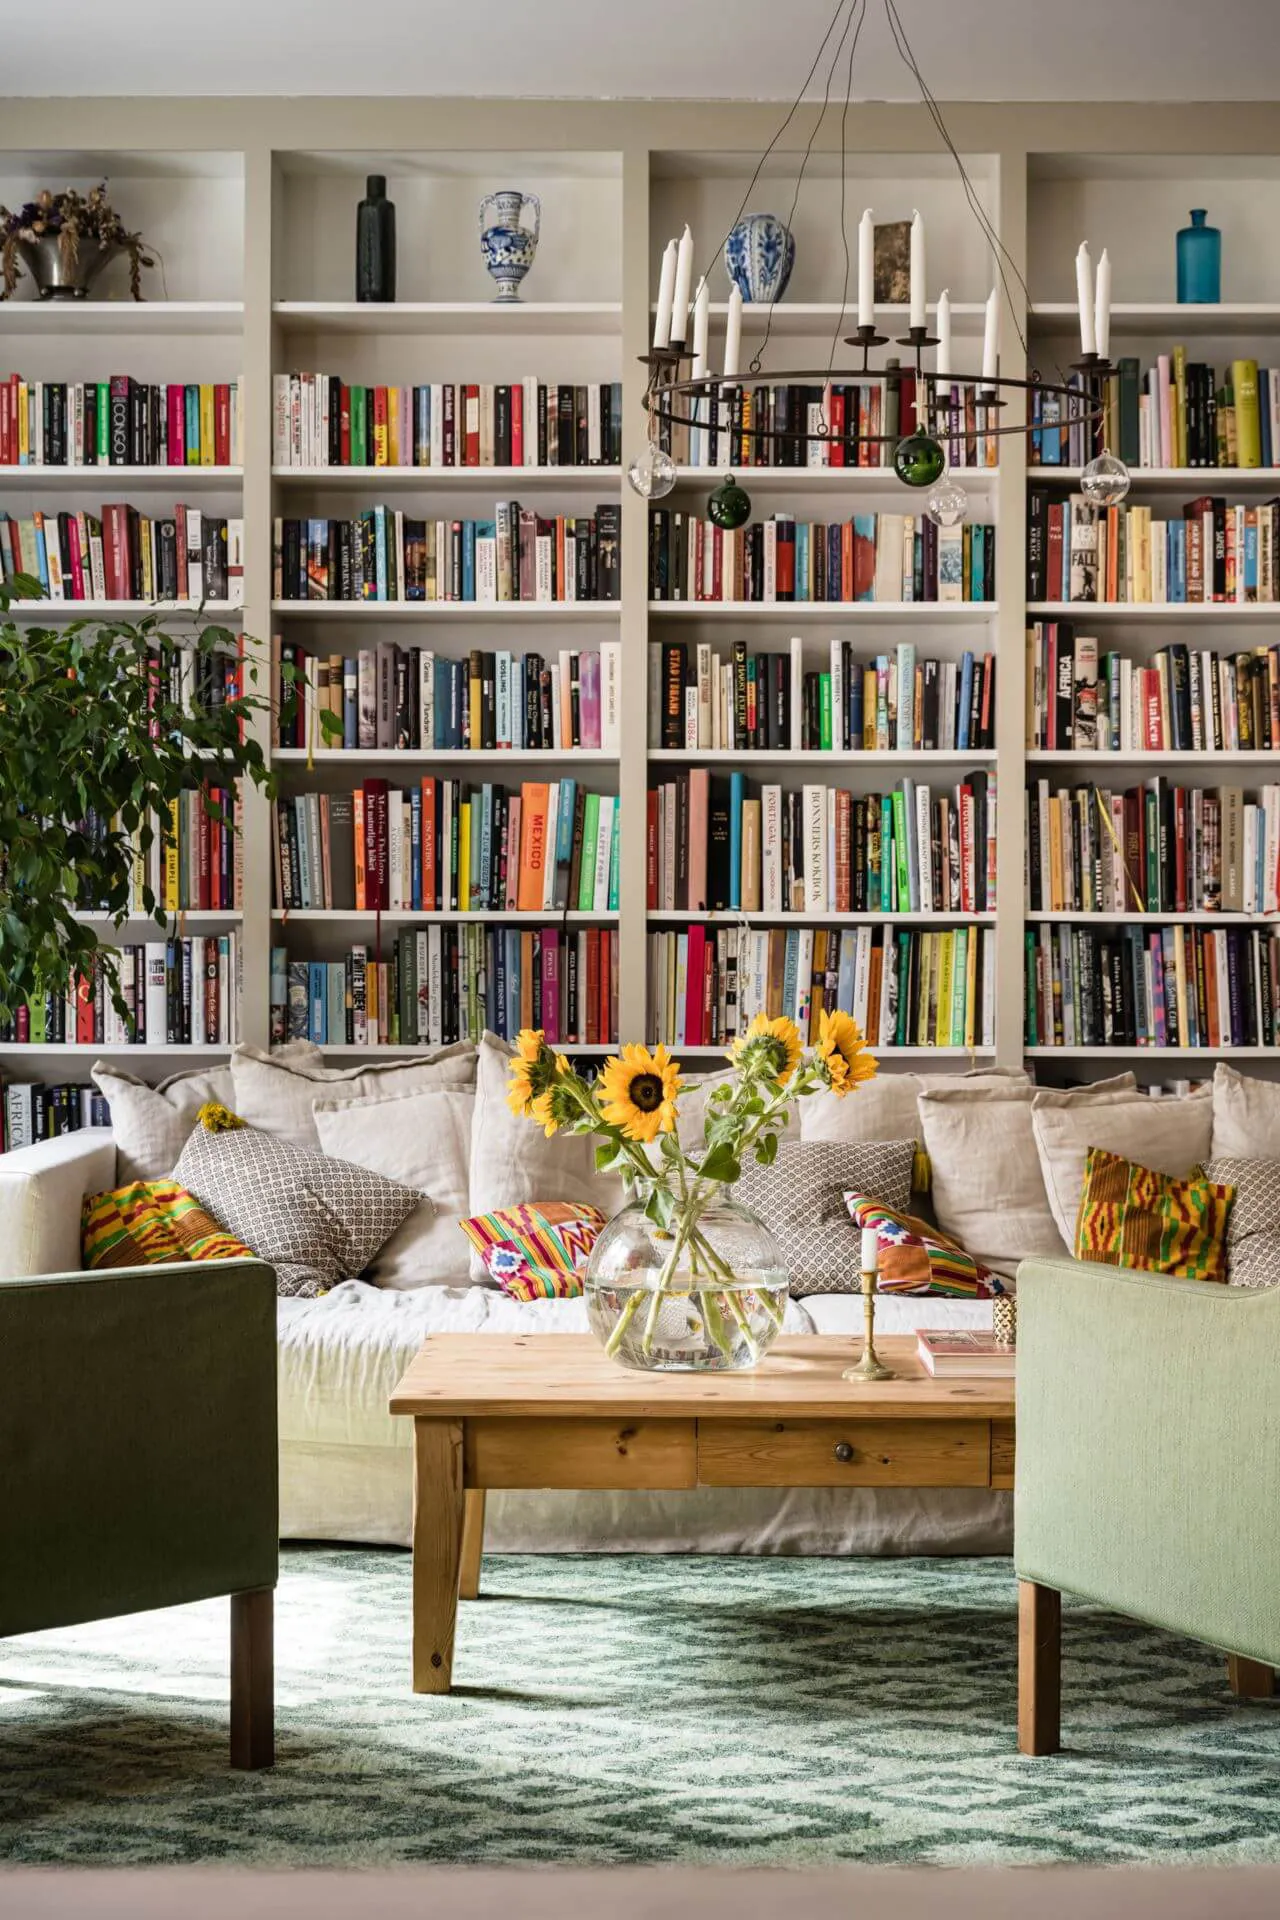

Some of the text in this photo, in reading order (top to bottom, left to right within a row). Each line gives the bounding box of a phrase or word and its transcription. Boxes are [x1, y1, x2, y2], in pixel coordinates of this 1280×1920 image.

[113, 403, 126, 455] CONGO
[276, 394, 287, 437] Sapiens
[1072, 552, 1096, 566] FALL
[531, 814, 544, 870] MEXICO
[768, 791, 776, 847] PORTUGAL
[168, 854, 176, 885] SIMPLE
[281, 843, 292, 899] 52 SOPPOR
[354, 984, 367, 1012] TIGER
[11, 1091, 23, 1148] AFRICA
